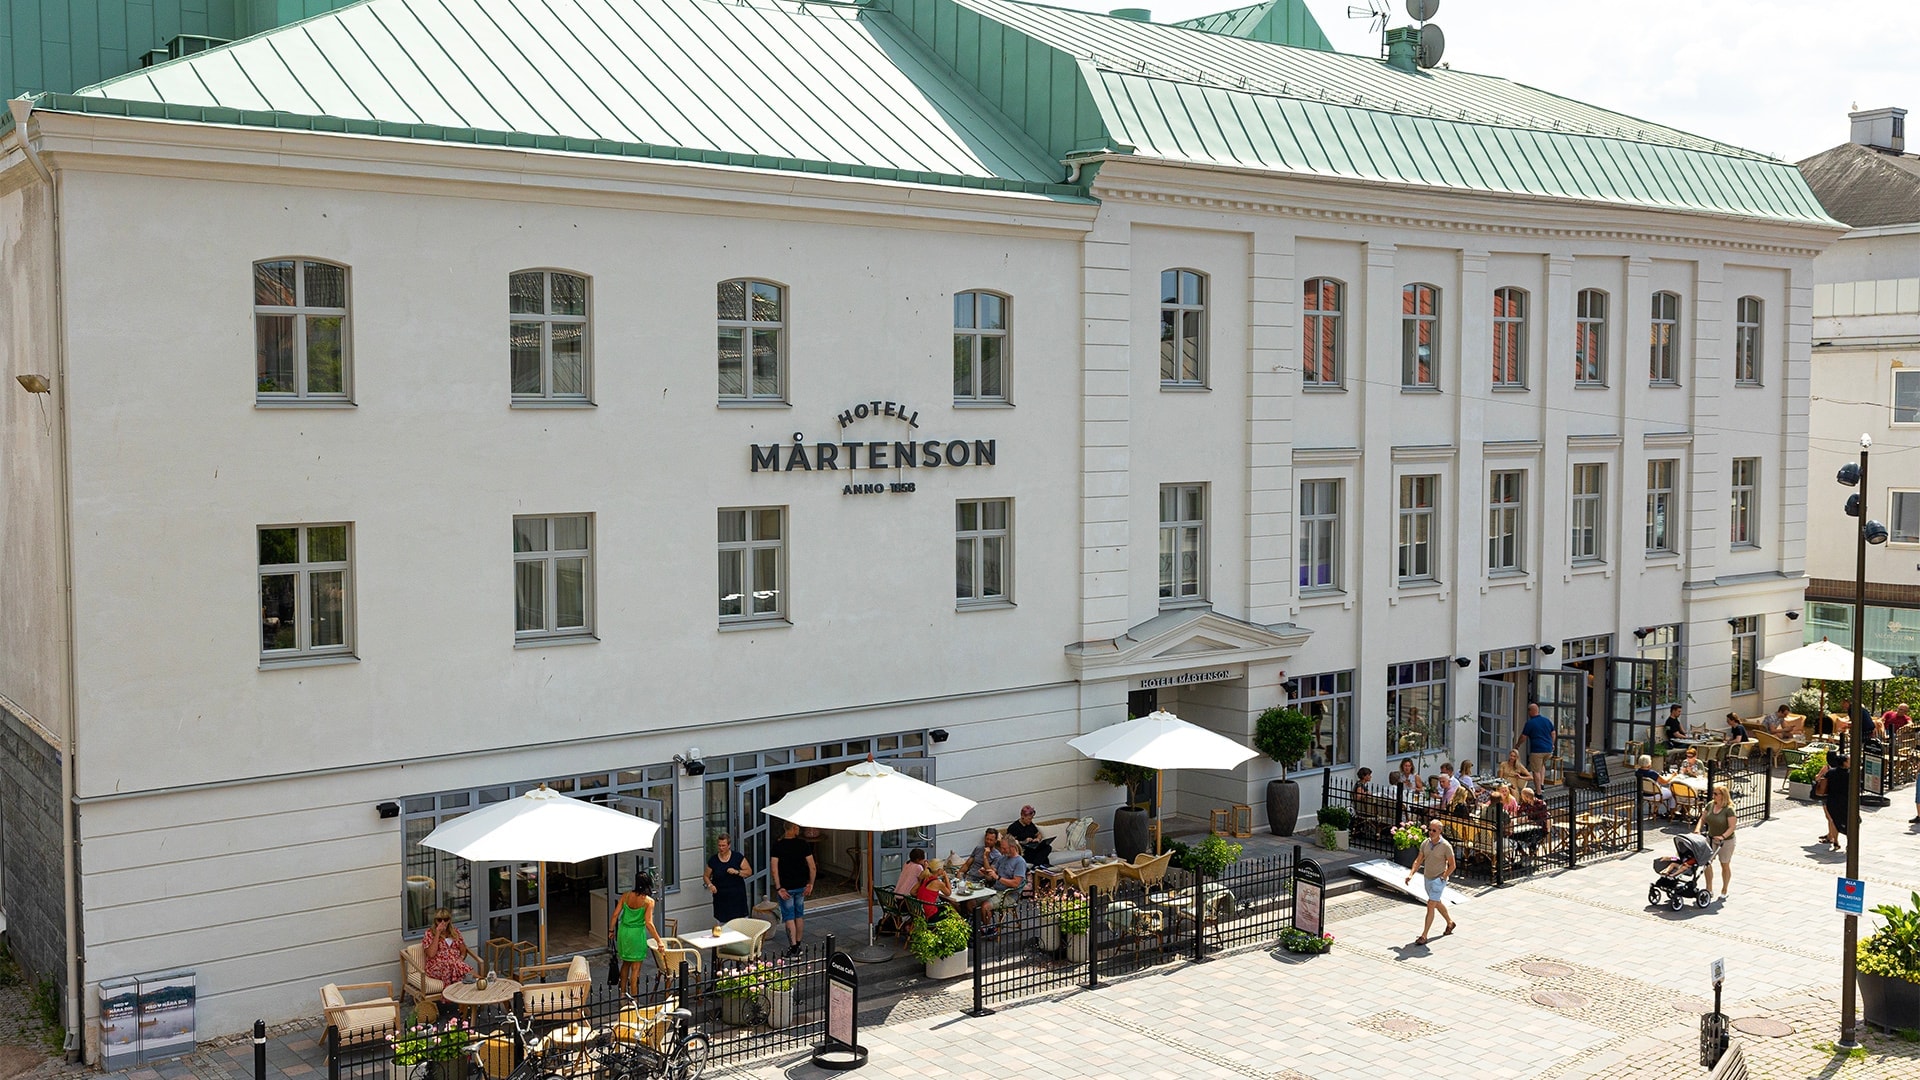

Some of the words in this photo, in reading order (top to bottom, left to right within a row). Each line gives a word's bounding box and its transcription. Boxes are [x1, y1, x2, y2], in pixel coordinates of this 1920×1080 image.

[837, 401, 920, 429] HOTELL
[751, 431, 996, 473] MÅRTENSON
[842, 483, 885, 495] ANNO
[890, 482, 916, 494] 1858
[1141, 676, 1176, 688] HOTELL
[1178, 669, 1231, 684] MÅRTENSON
